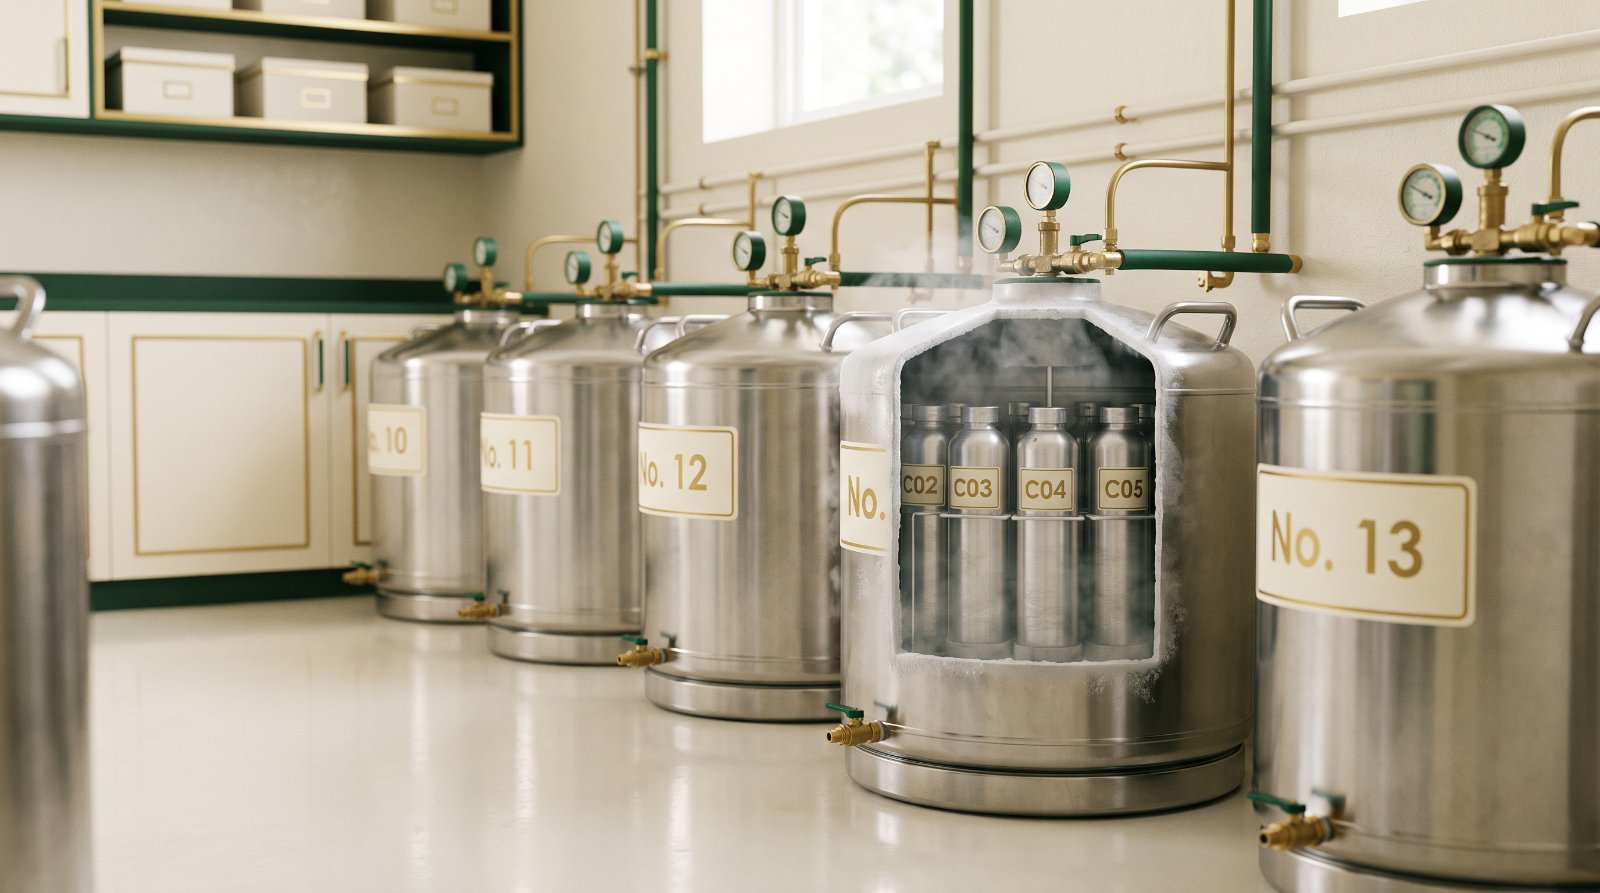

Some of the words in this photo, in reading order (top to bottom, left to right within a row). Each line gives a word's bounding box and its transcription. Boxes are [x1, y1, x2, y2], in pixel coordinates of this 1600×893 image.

[385, 426, 407, 454] 10
[509, 439, 532, 471] 11
[640, 451, 664, 488] No.
[674, 454, 707, 491] 12
[903, 475, 938, 495] C02
[848, 475, 886, 521] No.
[954, 478, 993, 498] C03
[1025, 479, 1067, 499] C04
[1105, 479, 1143, 499] C05
[1272, 510, 1334, 571] No.
[1359, 519, 1424, 578] 13
